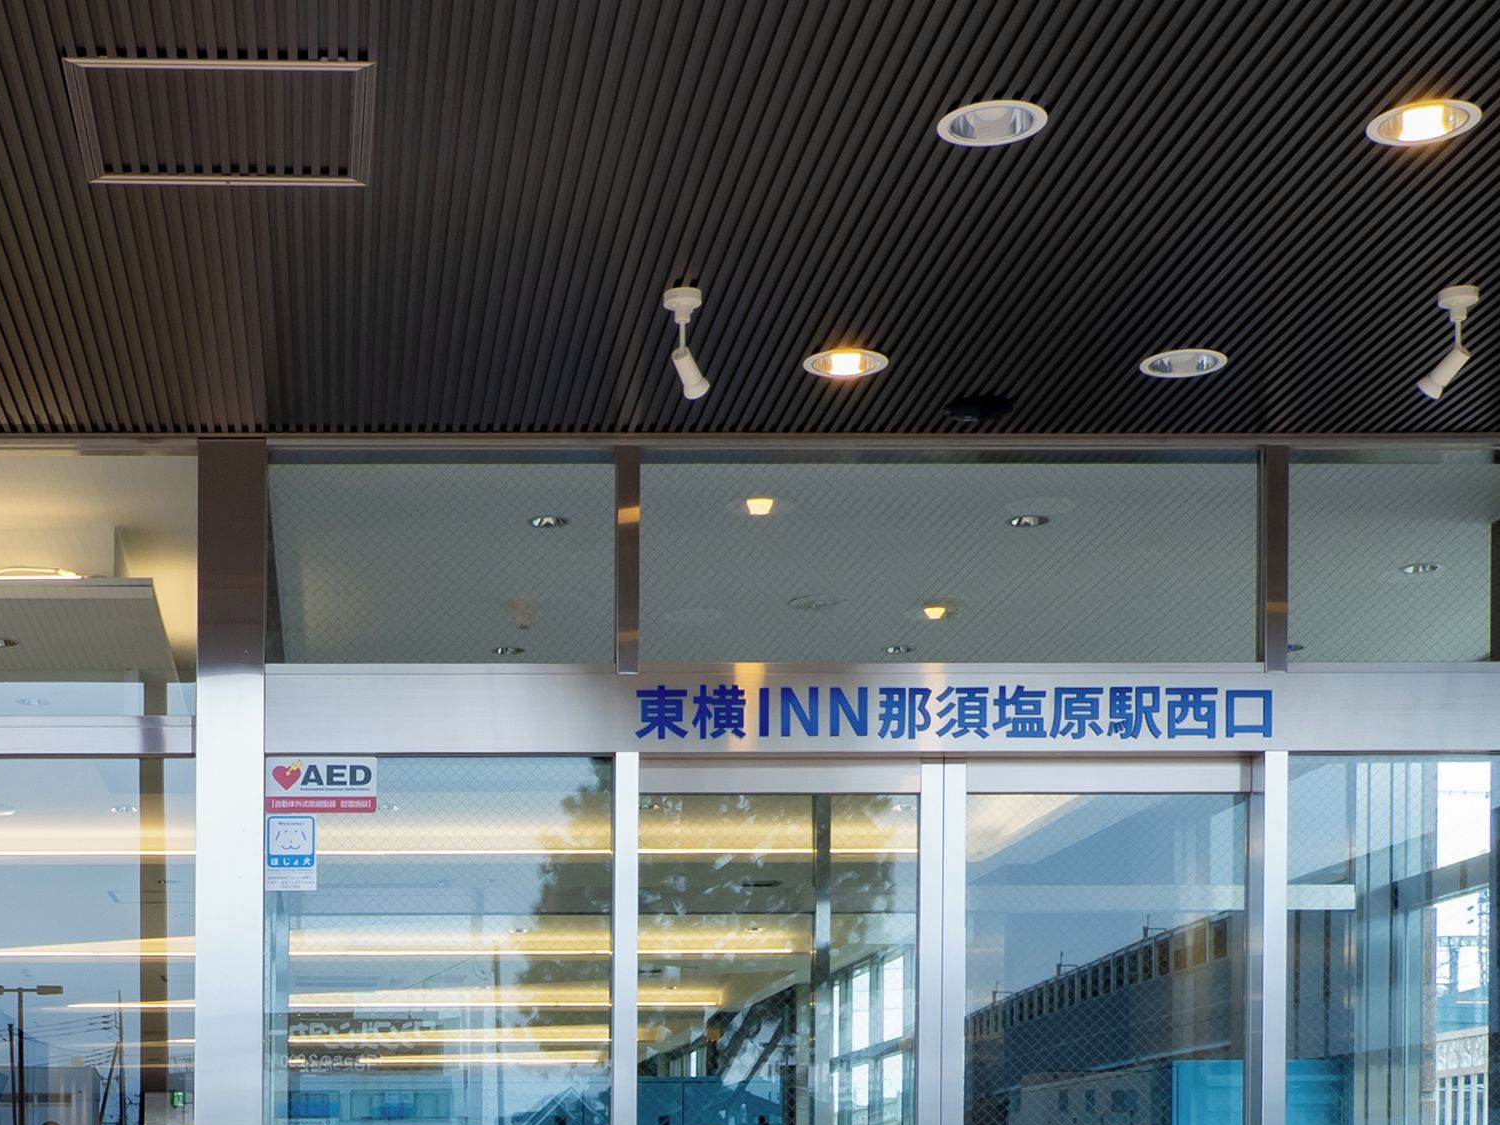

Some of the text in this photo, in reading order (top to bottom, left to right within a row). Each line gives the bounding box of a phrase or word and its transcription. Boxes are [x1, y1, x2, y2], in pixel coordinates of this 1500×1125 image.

[634, 684, 1273, 740] 東横INN那須塩原駅西口
[300, 764, 372, 786] AED
